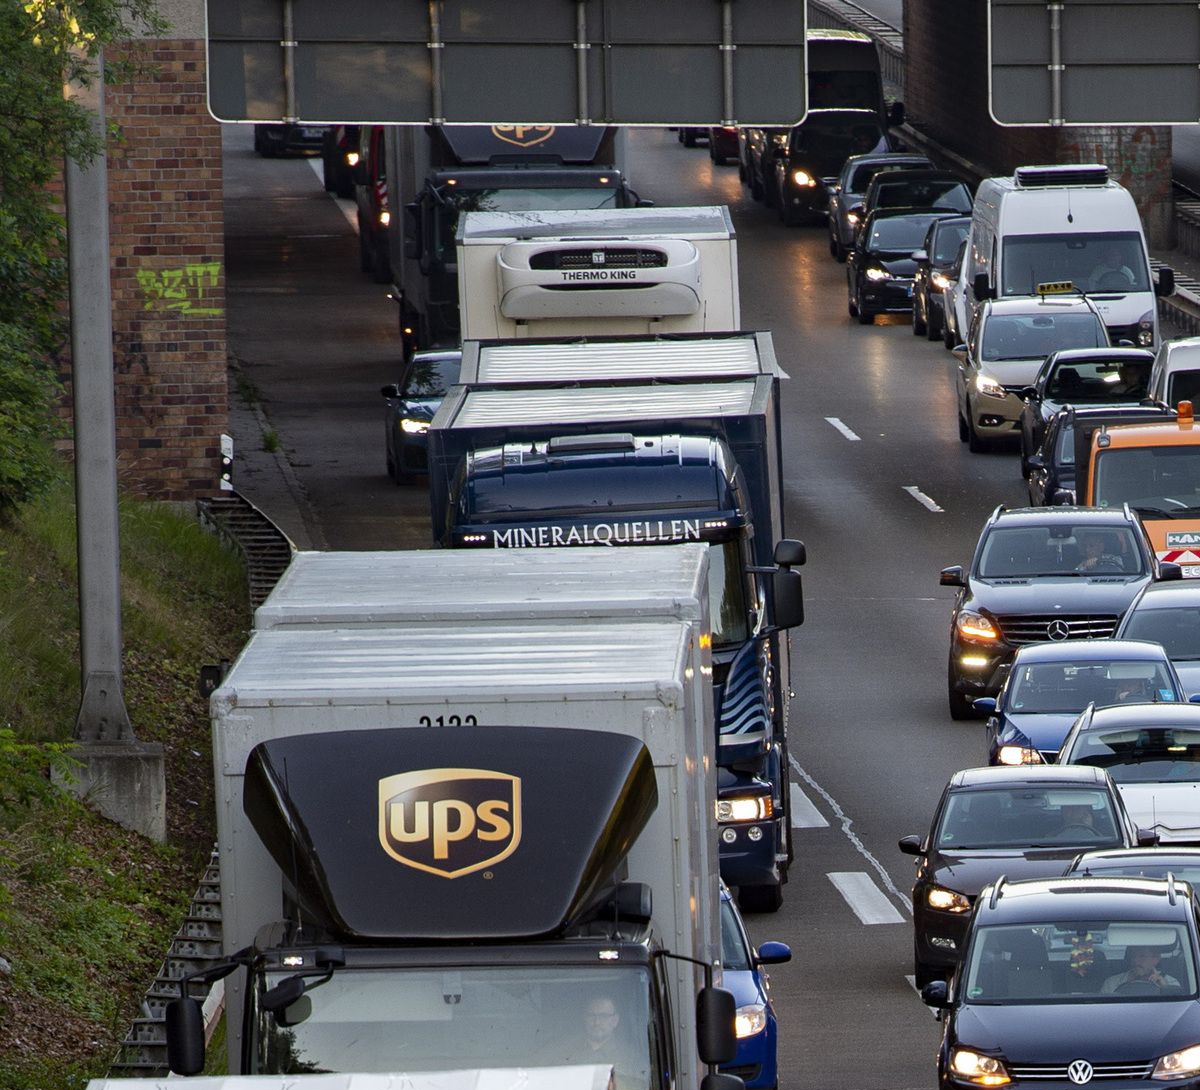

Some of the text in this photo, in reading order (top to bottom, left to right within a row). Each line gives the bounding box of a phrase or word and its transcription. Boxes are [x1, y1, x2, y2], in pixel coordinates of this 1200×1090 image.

[561, 271, 636, 280] THERMO KING
[493, 519, 700, 548] MINERALQUELLEN
[390, 799, 511, 860] ups
